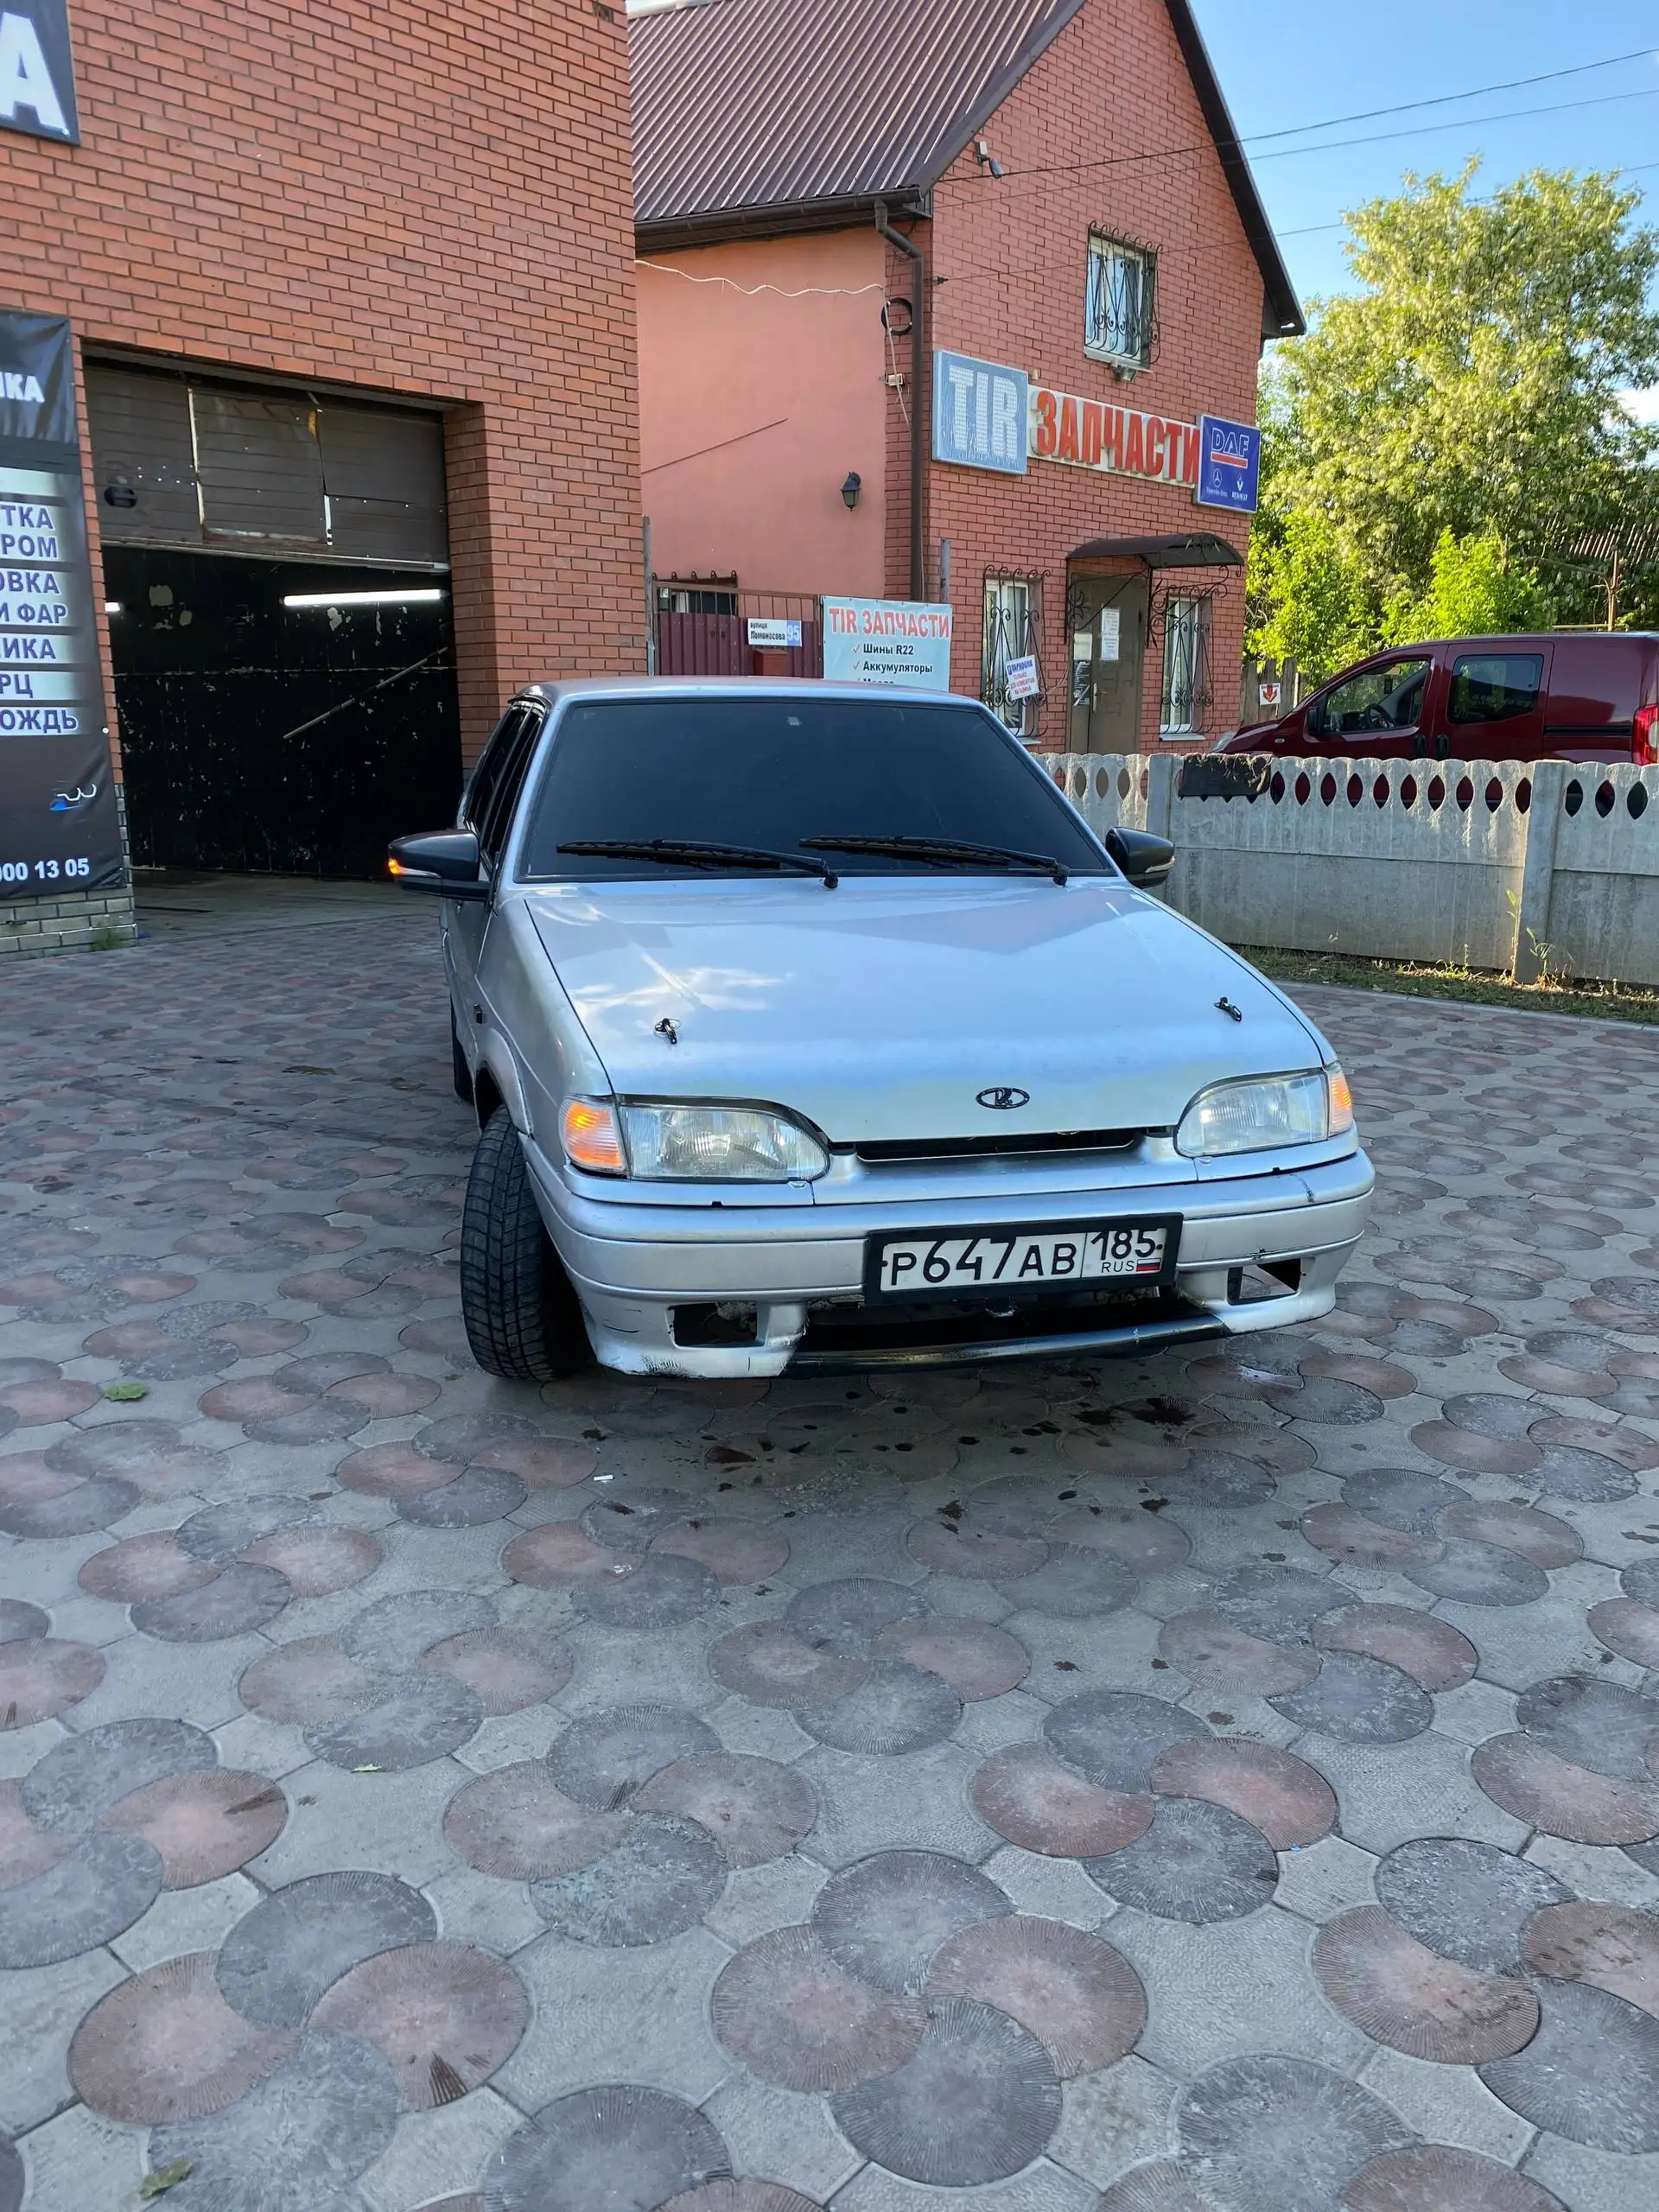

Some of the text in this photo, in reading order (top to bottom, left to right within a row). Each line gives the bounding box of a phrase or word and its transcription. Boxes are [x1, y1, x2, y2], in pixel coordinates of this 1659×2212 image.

[0, 372, 45, 403] КА
[949, 365, 1018, 461] TIR
[1035, 390, 1199, 485] ЗАПЧАСТИ
[1211, 427, 1249, 458] DAF
[0, 505, 54, 529] ТКА
[0, 533, 58, 558] РОМ
[17, 603, 67, 624] ФАР
[829, 607, 949, 638] TIR ЗАПЧАСТИ
[787, 625, 800, 641] 95
[864, 644, 913, 655] Шины R22
[863, 661, 932, 674] Аккумуляторы
[0, 858, 90, 881] 00 13 05
[1091, 1230, 1155, 1260] 185
[1102, 1261, 1134, 1273] RUS
